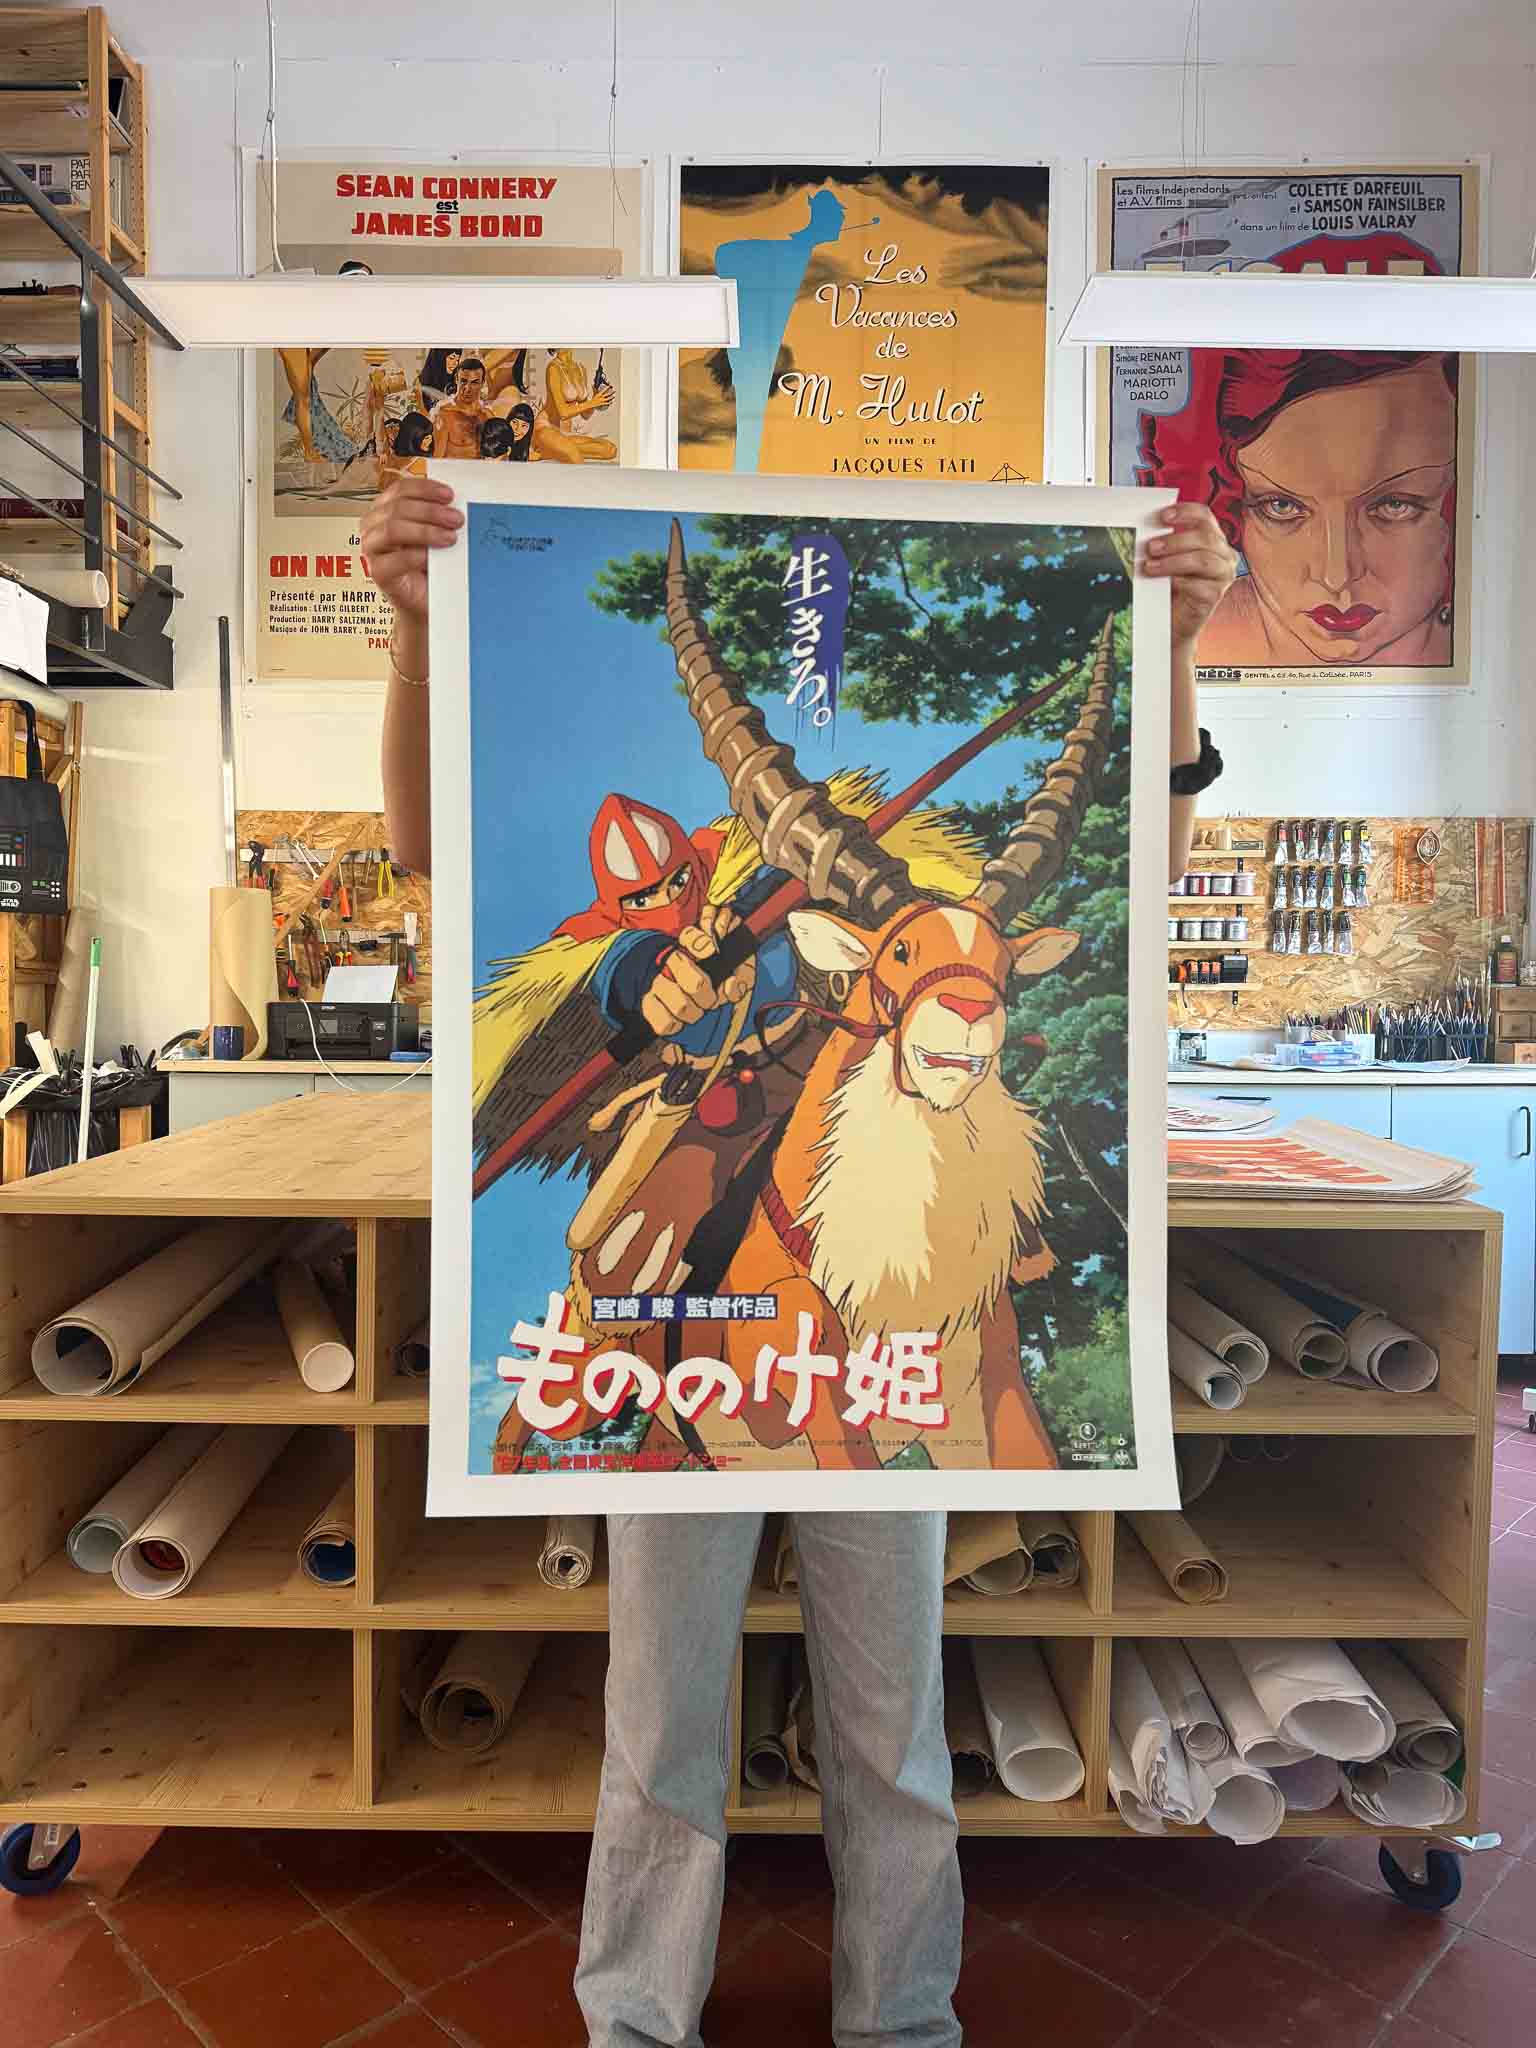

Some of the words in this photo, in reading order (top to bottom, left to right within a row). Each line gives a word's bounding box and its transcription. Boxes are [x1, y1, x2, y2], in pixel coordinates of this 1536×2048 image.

[336, 174, 414, 199] SEAN
[422, 177, 558, 200] CONNERY
[1117, 185, 1133, 196] Les
[1136, 184, 1160, 196] films
[1288, 183, 1348, 198] COLETTE
[1354, 181, 1425, 196] DARFEUIL
[436, 200, 459, 212] est
[1129, 197, 1153, 207] A.V.
[1156, 195, 1182, 207] films
[1304, 200, 1363, 214] SAMSON
[1368, 198, 1446, 212] FAINSILBER
[352, 212, 451, 238] JAMES
[460, 215, 543, 238] BOND
[1240, 223, 1264, 231] dans
[1280, 220, 1296, 232] film
[1297, 222, 1309, 231] de
[1312, 215, 1353, 231] LOUIS
[1359, 214, 1417, 230] VALRAY
[864, 244, 929, 285] Les
[815, 283, 958, 329] Vacances
[875, 331, 910, 360] de
[1140, 351, 1184, 362] RENANT
[1149, 364, 1183, 375] SAALA
[1123, 377, 1176, 389] MARIOTTI
[777, 371, 845, 426] M.
[859, 372, 984, 427] Hulot
[1130, 390, 1169, 401] DARLO
[864, 437, 880, 446] UN
[888, 437, 914, 446] FILM
[831, 457, 923, 475] JACQUES
[937, 457, 975, 474] TATI
[270, 555, 308, 578] ON
[315, 555, 353, 578] NE
[270, 590, 315, 602] Présenté
[320, 592, 337, 604] par
[342, 591, 377, 603] HARRY
[314, 604, 336, 613] LEWIS
[339, 605, 369, 614] GILBERT
[312, 615, 336, 624] HARRY
[339, 616, 376, 625] SALTZMAN
[380, 617, 387, 625] et
[270, 625, 297, 635] Musique
[300, 625, 308, 633] de
[311, 625, 330, 634] JOHN
[333, 626, 357, 634] BARRY
[365, 626, 388, 635] Décors
[780, 547, 833, 728] 生きろ。
[497, 1292, 950, 1431] もののけ姫
